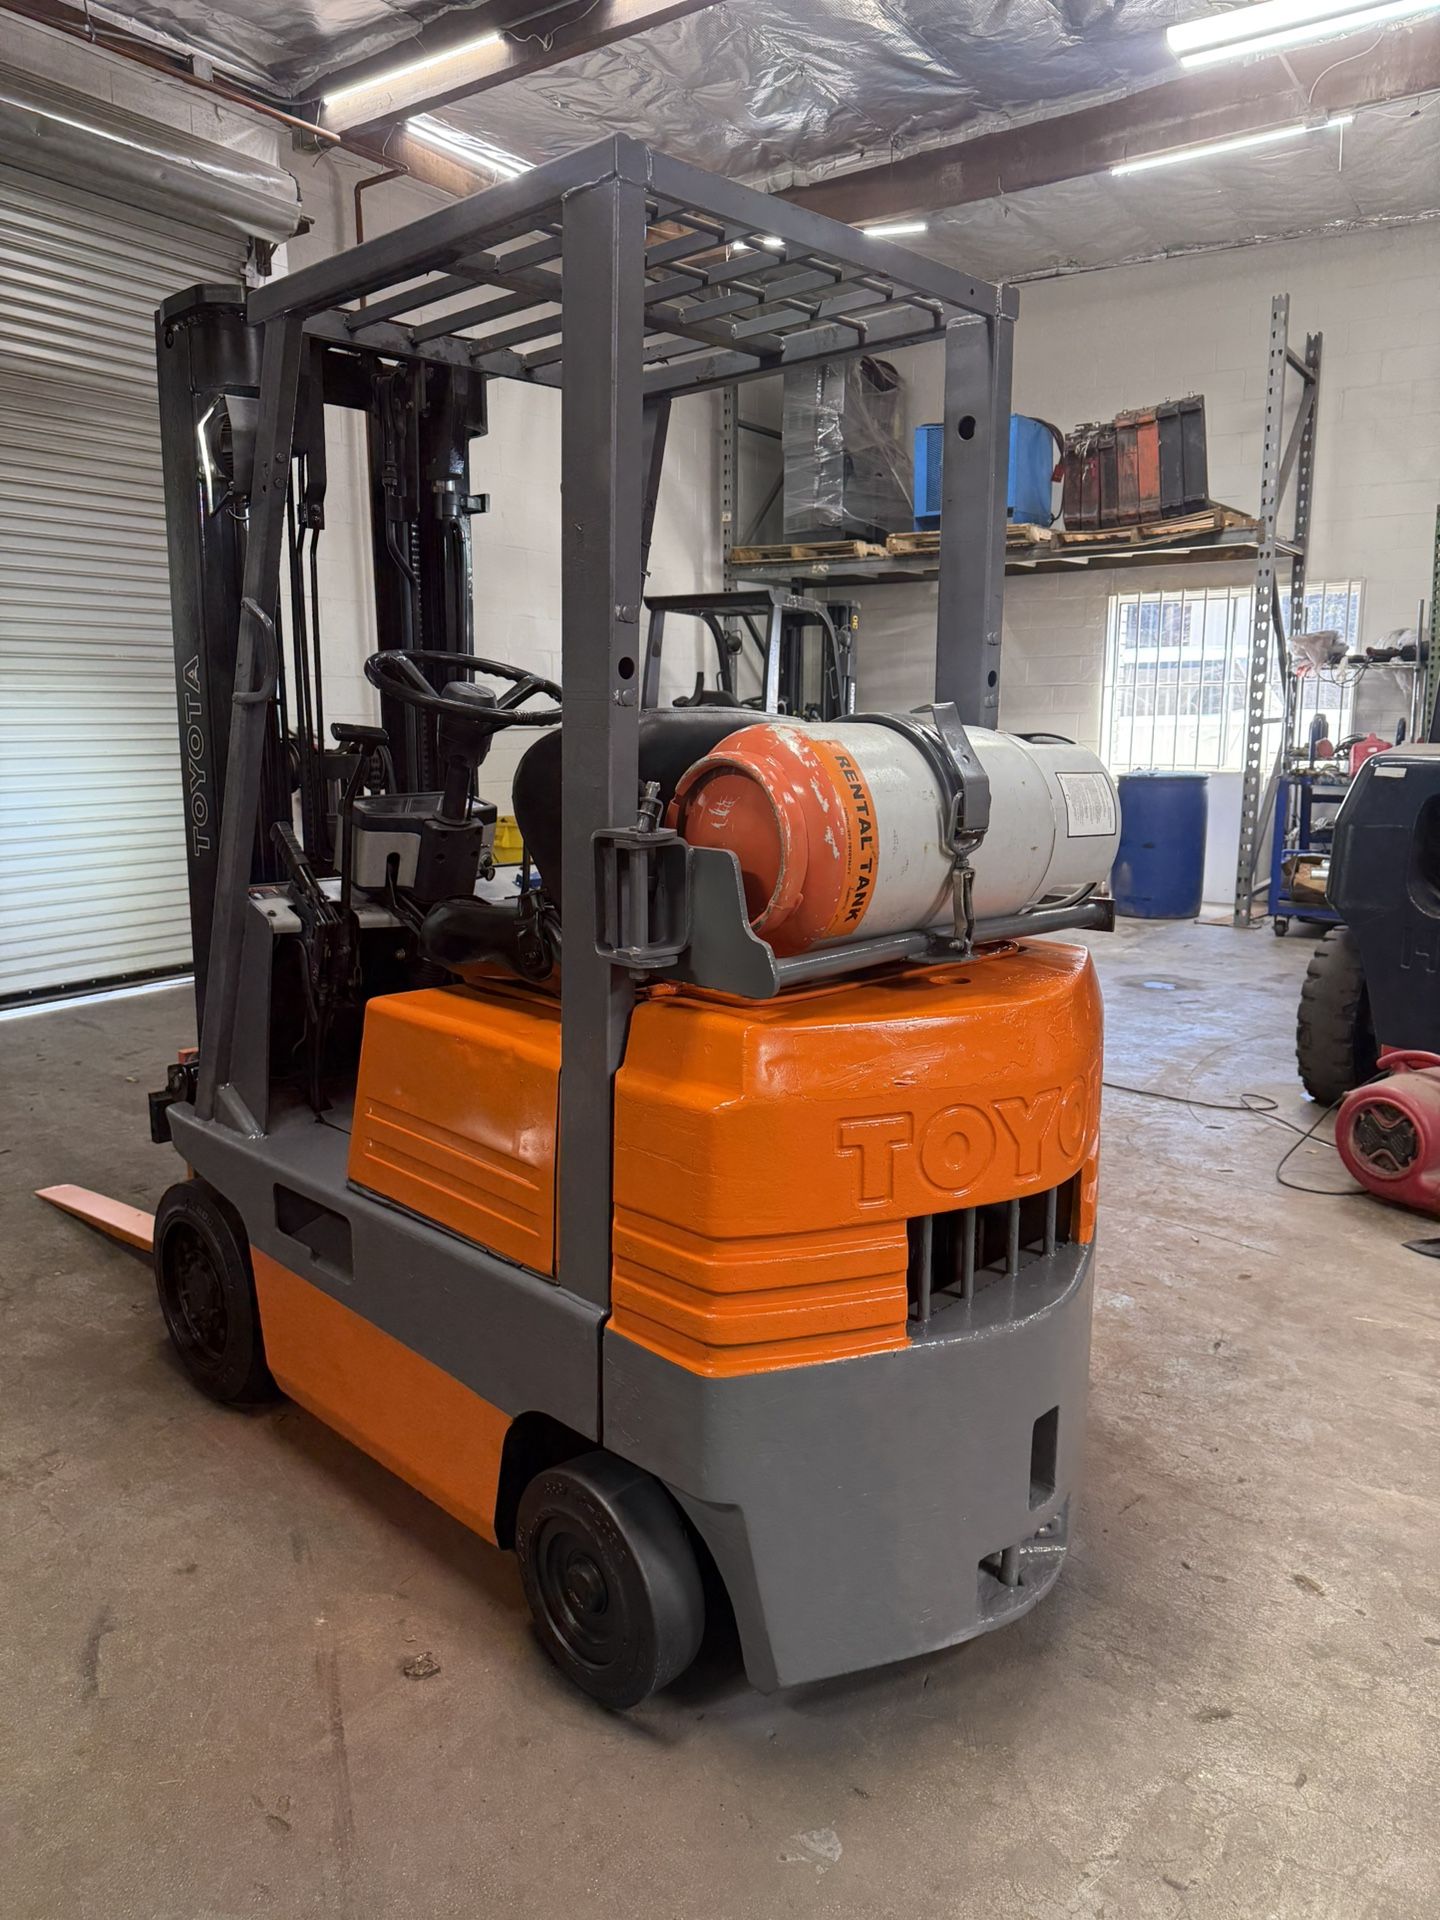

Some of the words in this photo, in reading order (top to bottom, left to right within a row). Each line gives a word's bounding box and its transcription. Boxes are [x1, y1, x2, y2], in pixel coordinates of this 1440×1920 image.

[183, 654, 210, 857] TOYOTA
[834, 755, 873, 851] RENTAL
[844, 857, 873, 923] TANK
[834, 1075, 1090, 1210] TOYO
